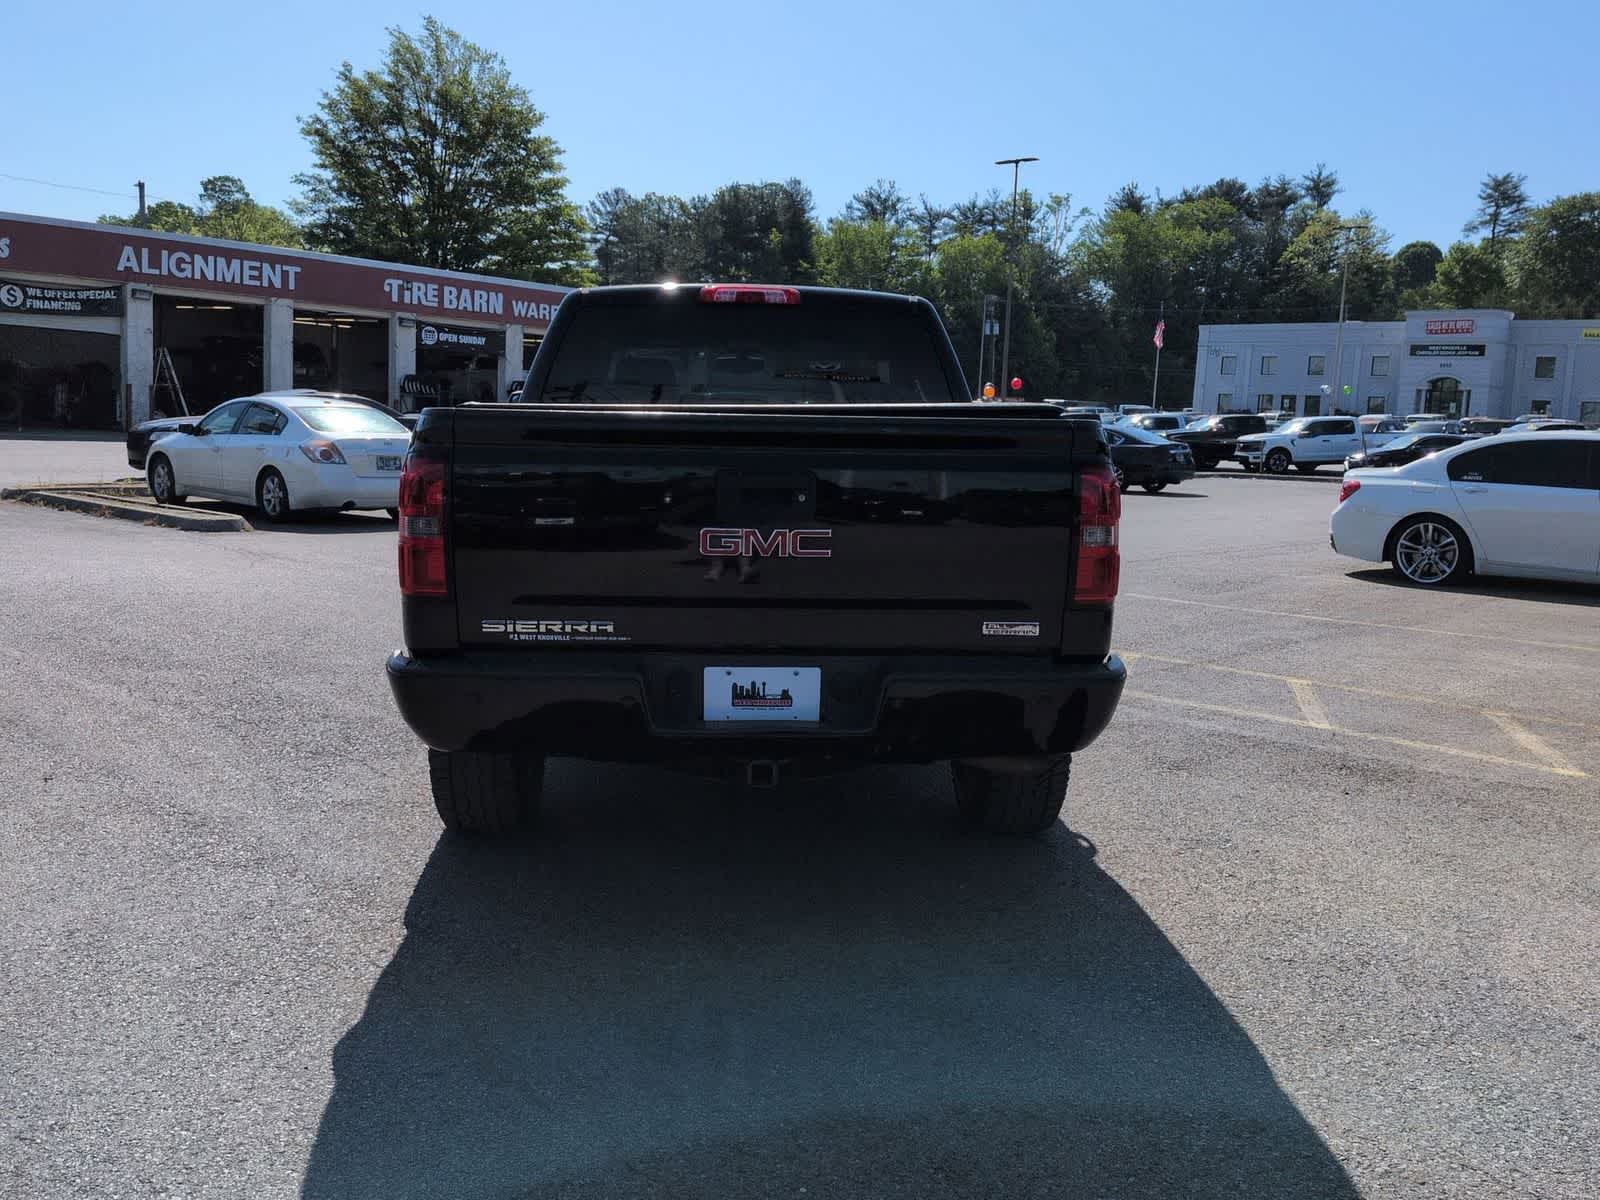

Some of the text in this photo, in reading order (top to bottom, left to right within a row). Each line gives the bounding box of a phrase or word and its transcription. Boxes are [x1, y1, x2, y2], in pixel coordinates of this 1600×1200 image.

[117, 245, 301, 290] ALIGNMENT
[26, 287, 118, 300] WE OFFER SPECIAL
[443, 285, 504, 316] BARN
[26, 298, 82, 311] FINANCING
[438, 333, 487, 346] OPEN SUNDAY
[699, 527, 833, 558] GMC
[481, 619, 615, 633] SIERRA
